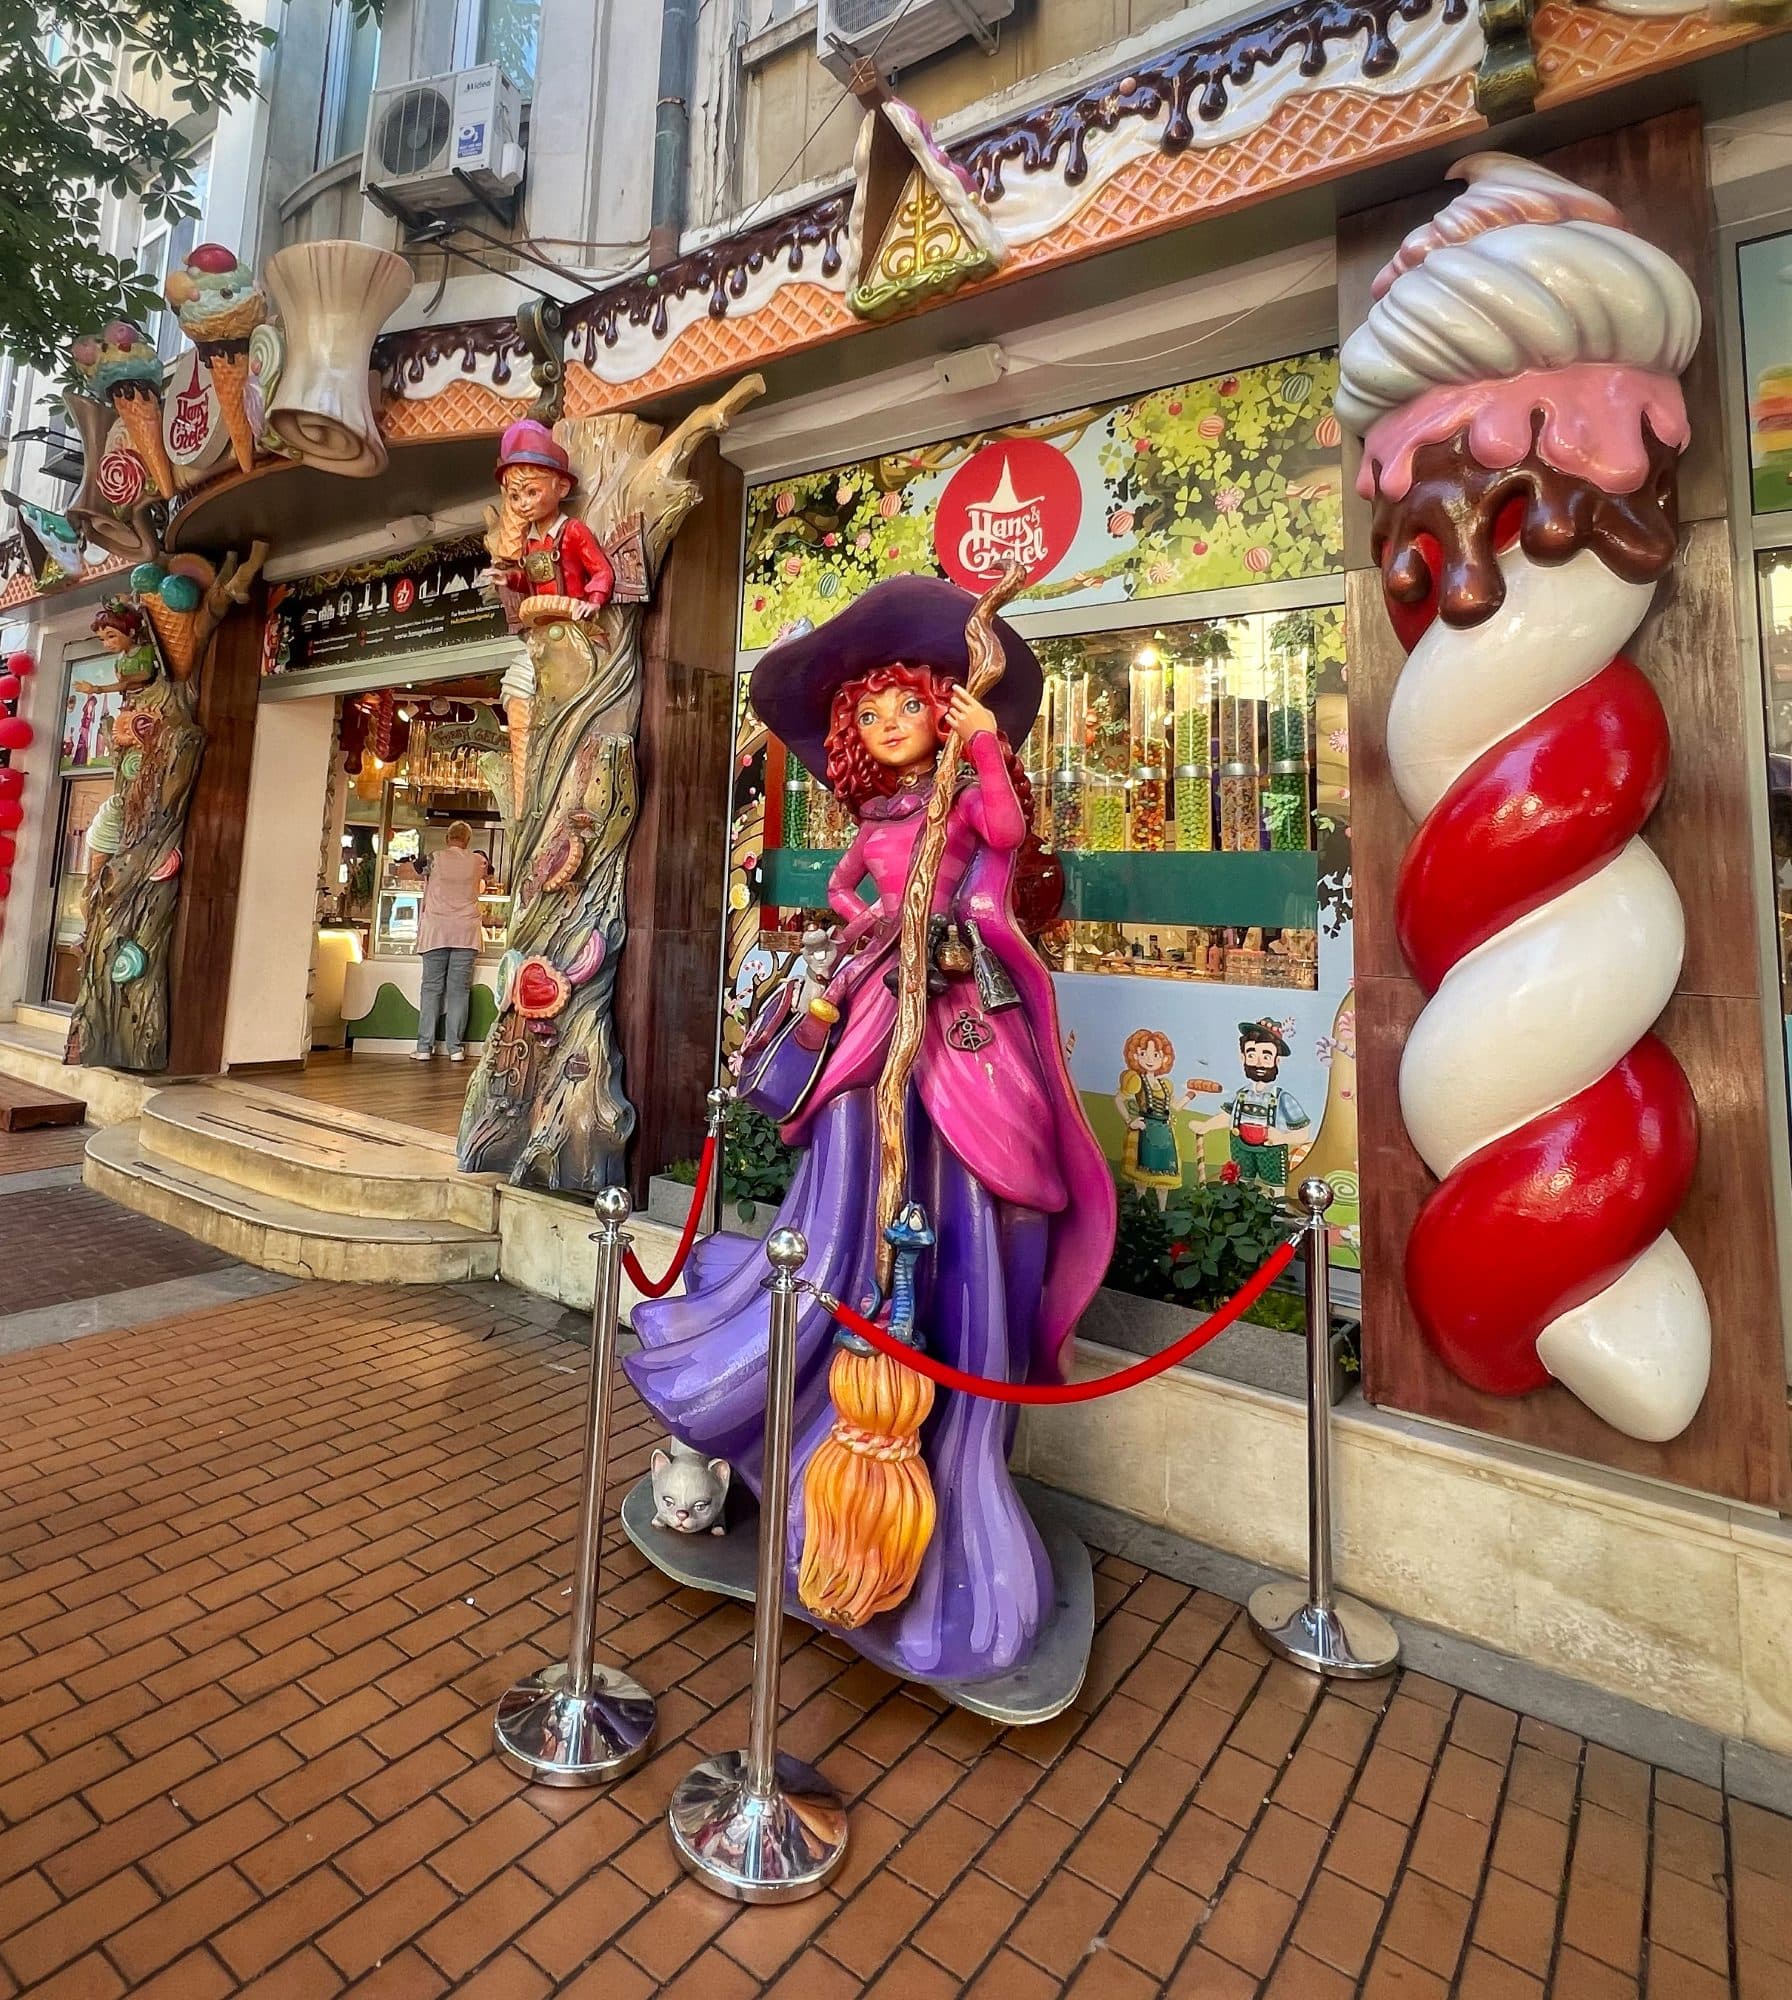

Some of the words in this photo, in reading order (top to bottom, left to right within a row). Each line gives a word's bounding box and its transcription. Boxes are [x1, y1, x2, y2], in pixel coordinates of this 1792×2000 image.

[464, 81, 491, 92] Midea
[176, 399, 207, 428] Hans
[169, 412, 210, 452] Gretel
[968, 510, 1034, 552] Hans
[1030, 505, 1041, 527] &
[958, 528, 1049, 574] Gretel
[397, 592, 409, 604] 27
